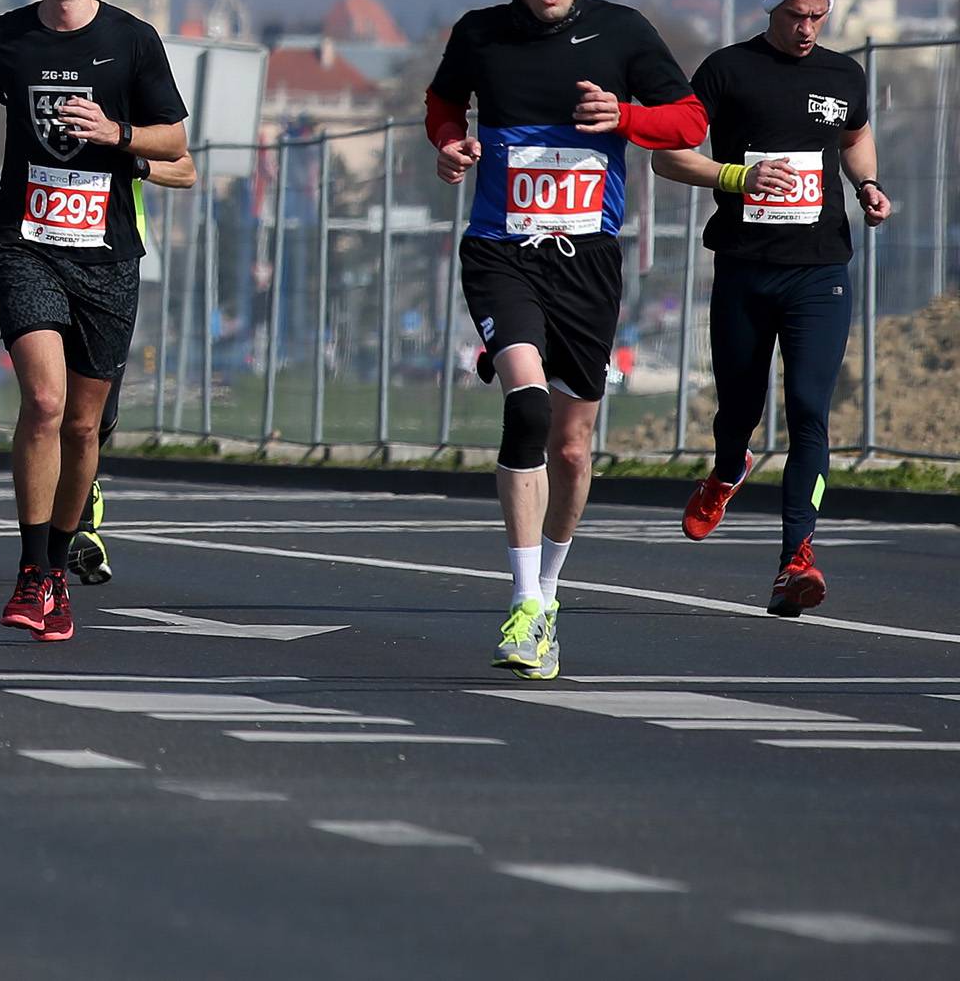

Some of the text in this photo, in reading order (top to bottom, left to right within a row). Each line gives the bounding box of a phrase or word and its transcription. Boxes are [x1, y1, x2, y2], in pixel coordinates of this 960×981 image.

[41, 70, 79, 81] ZG-BG
[512, 172, 602, 210] 0017
[749, 173, 820, 203] 98
[29, 187, 106, 226] 0295
